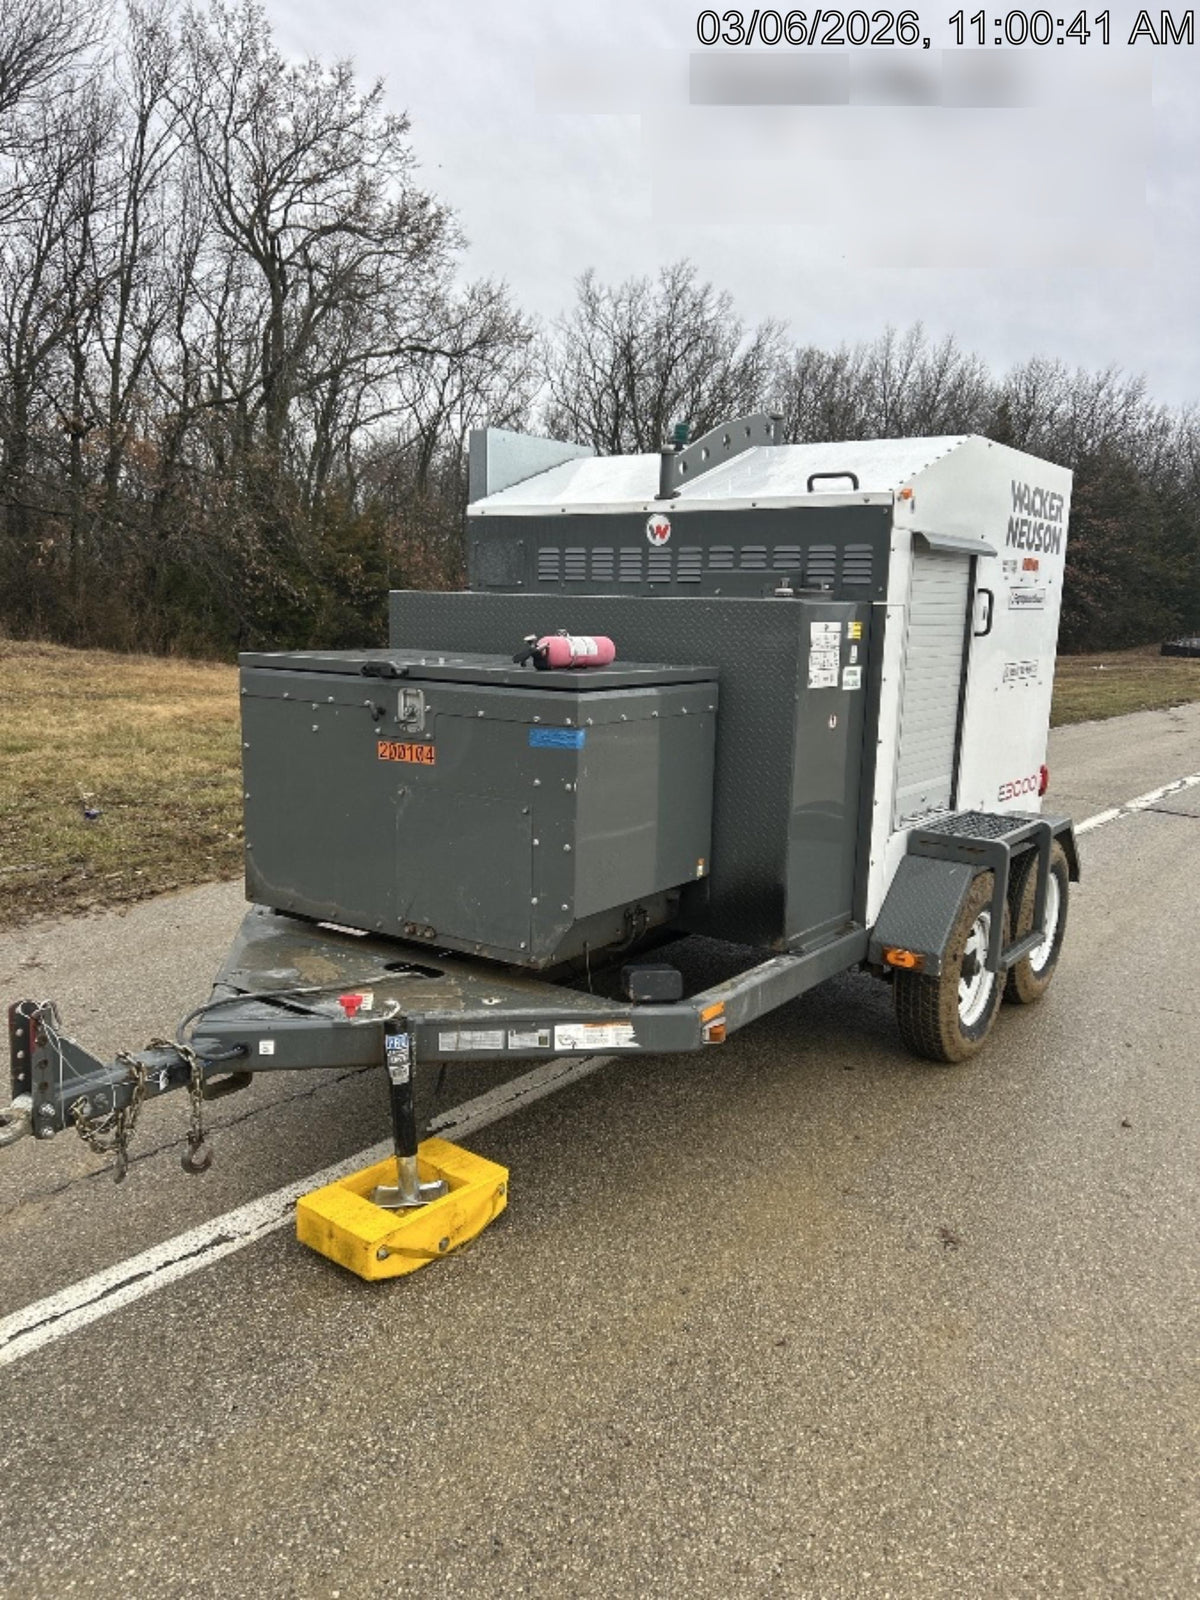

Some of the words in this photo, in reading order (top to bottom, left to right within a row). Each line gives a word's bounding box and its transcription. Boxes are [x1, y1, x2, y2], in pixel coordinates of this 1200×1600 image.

[1011, 480, 1063, 523] WACKER
[1006, 516, 1062, 555] NEUSON
[379, 742, 434, 763] 200104
